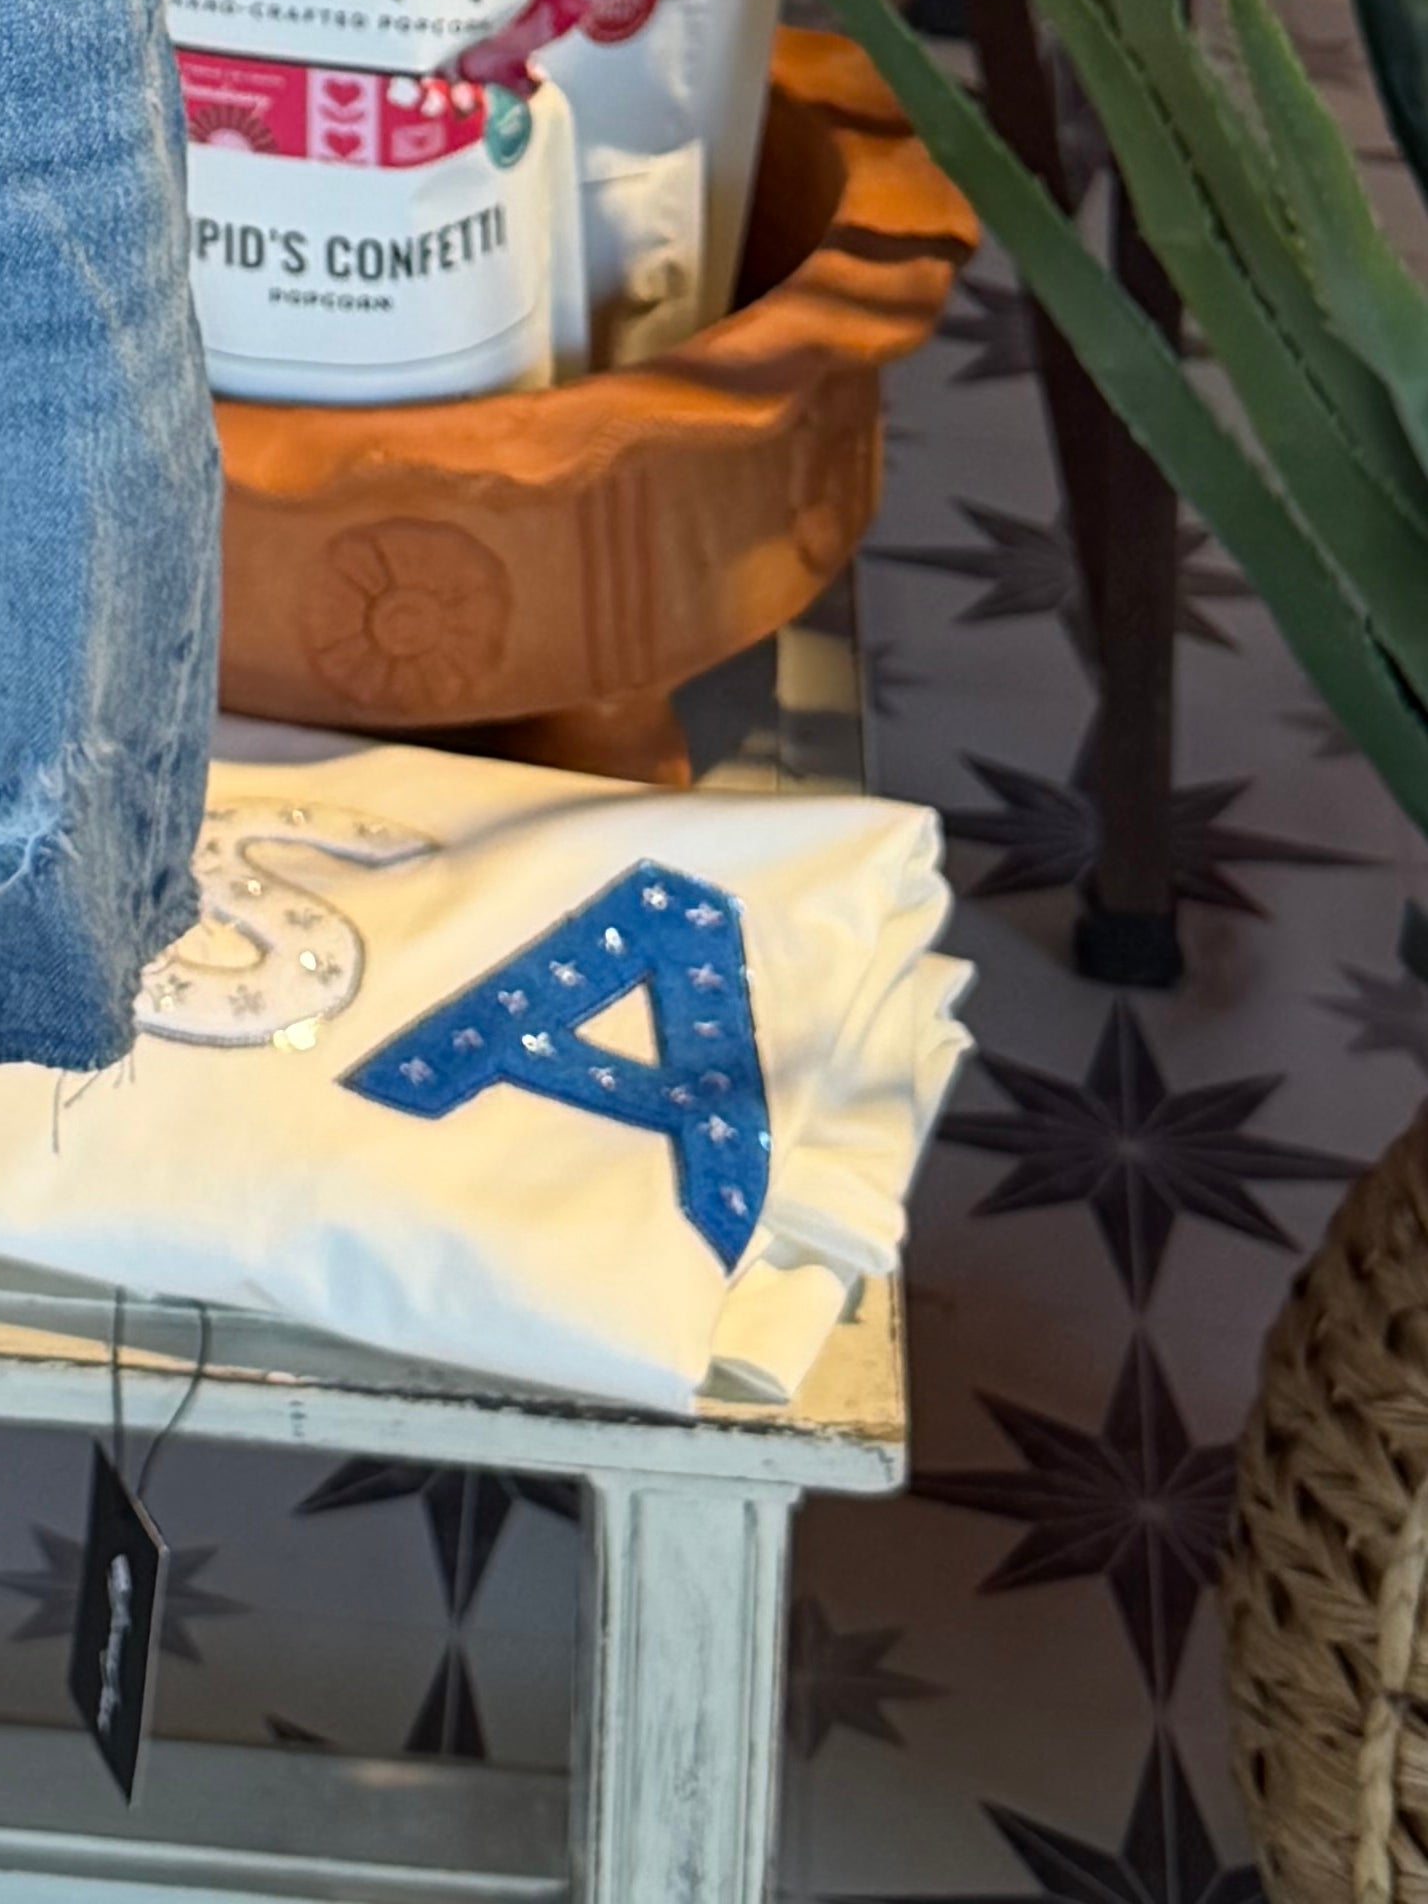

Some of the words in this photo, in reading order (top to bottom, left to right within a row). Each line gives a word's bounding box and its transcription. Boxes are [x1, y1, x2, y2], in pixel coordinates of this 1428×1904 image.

[190, 217, 307, 275] PID'S
[325, 204, 507, 282] CONFETTI
[267, 286, 395, 312] POPCORN
